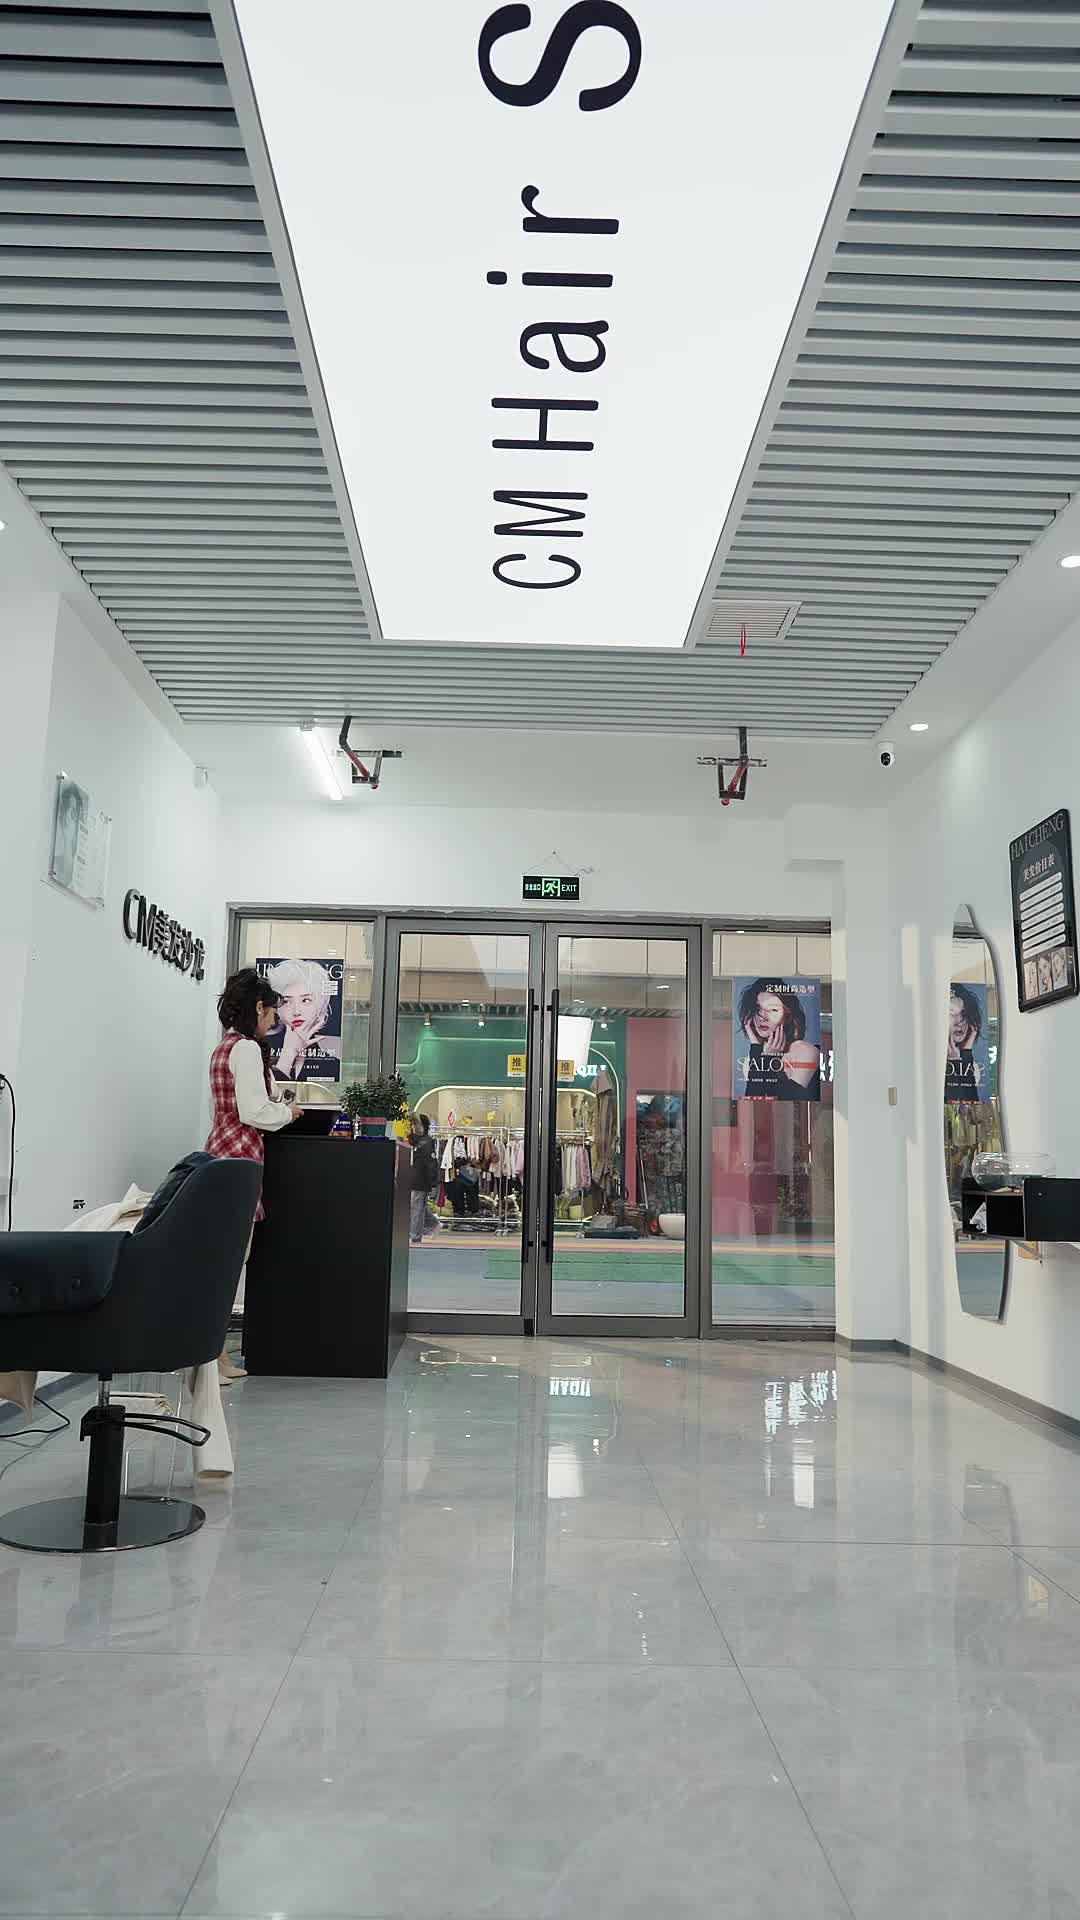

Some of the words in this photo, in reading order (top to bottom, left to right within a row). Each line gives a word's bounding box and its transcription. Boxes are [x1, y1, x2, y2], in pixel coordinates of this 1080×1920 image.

[487, 185, 619, 451] Hair
[493, 490, 588, 589] CM
[1011, 813, 1064, 861] HAICHENG
[561, 884, 577, 892] EXIT
[765, 984, 815, 993] 定制时尚造型
[737, 1057, 796, 1072] SALON
